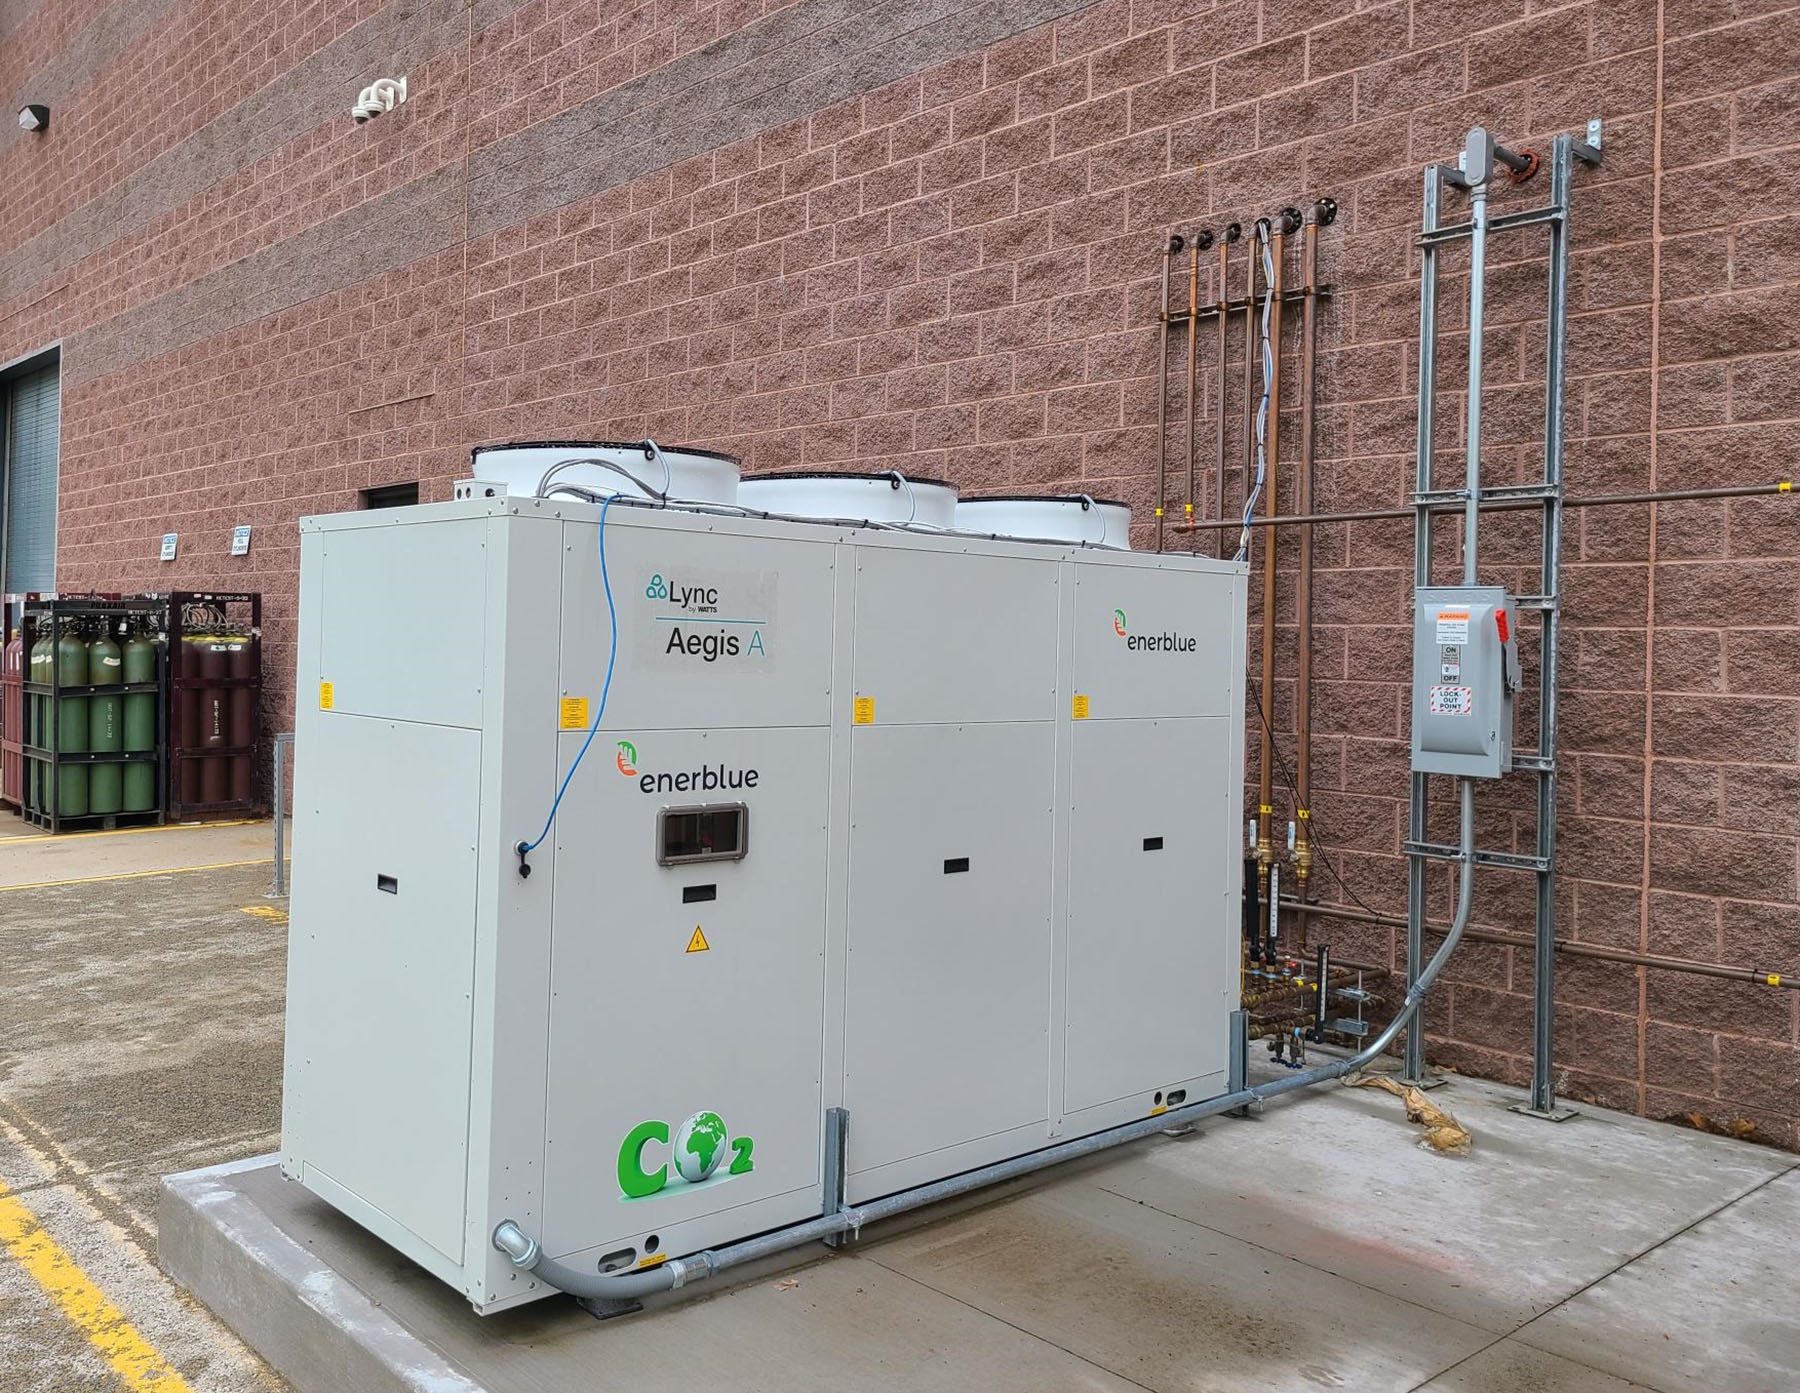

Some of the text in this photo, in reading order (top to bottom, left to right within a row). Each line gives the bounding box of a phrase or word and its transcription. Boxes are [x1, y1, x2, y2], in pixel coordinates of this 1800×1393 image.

[669, 581, 718, 608] Lync
[688, 606, 696, 614] by
[665, 627, 765, 662] Aegis A
[1127, 631, 1197, 652] enerblue
[639, 764, 759, 794] enerblue
